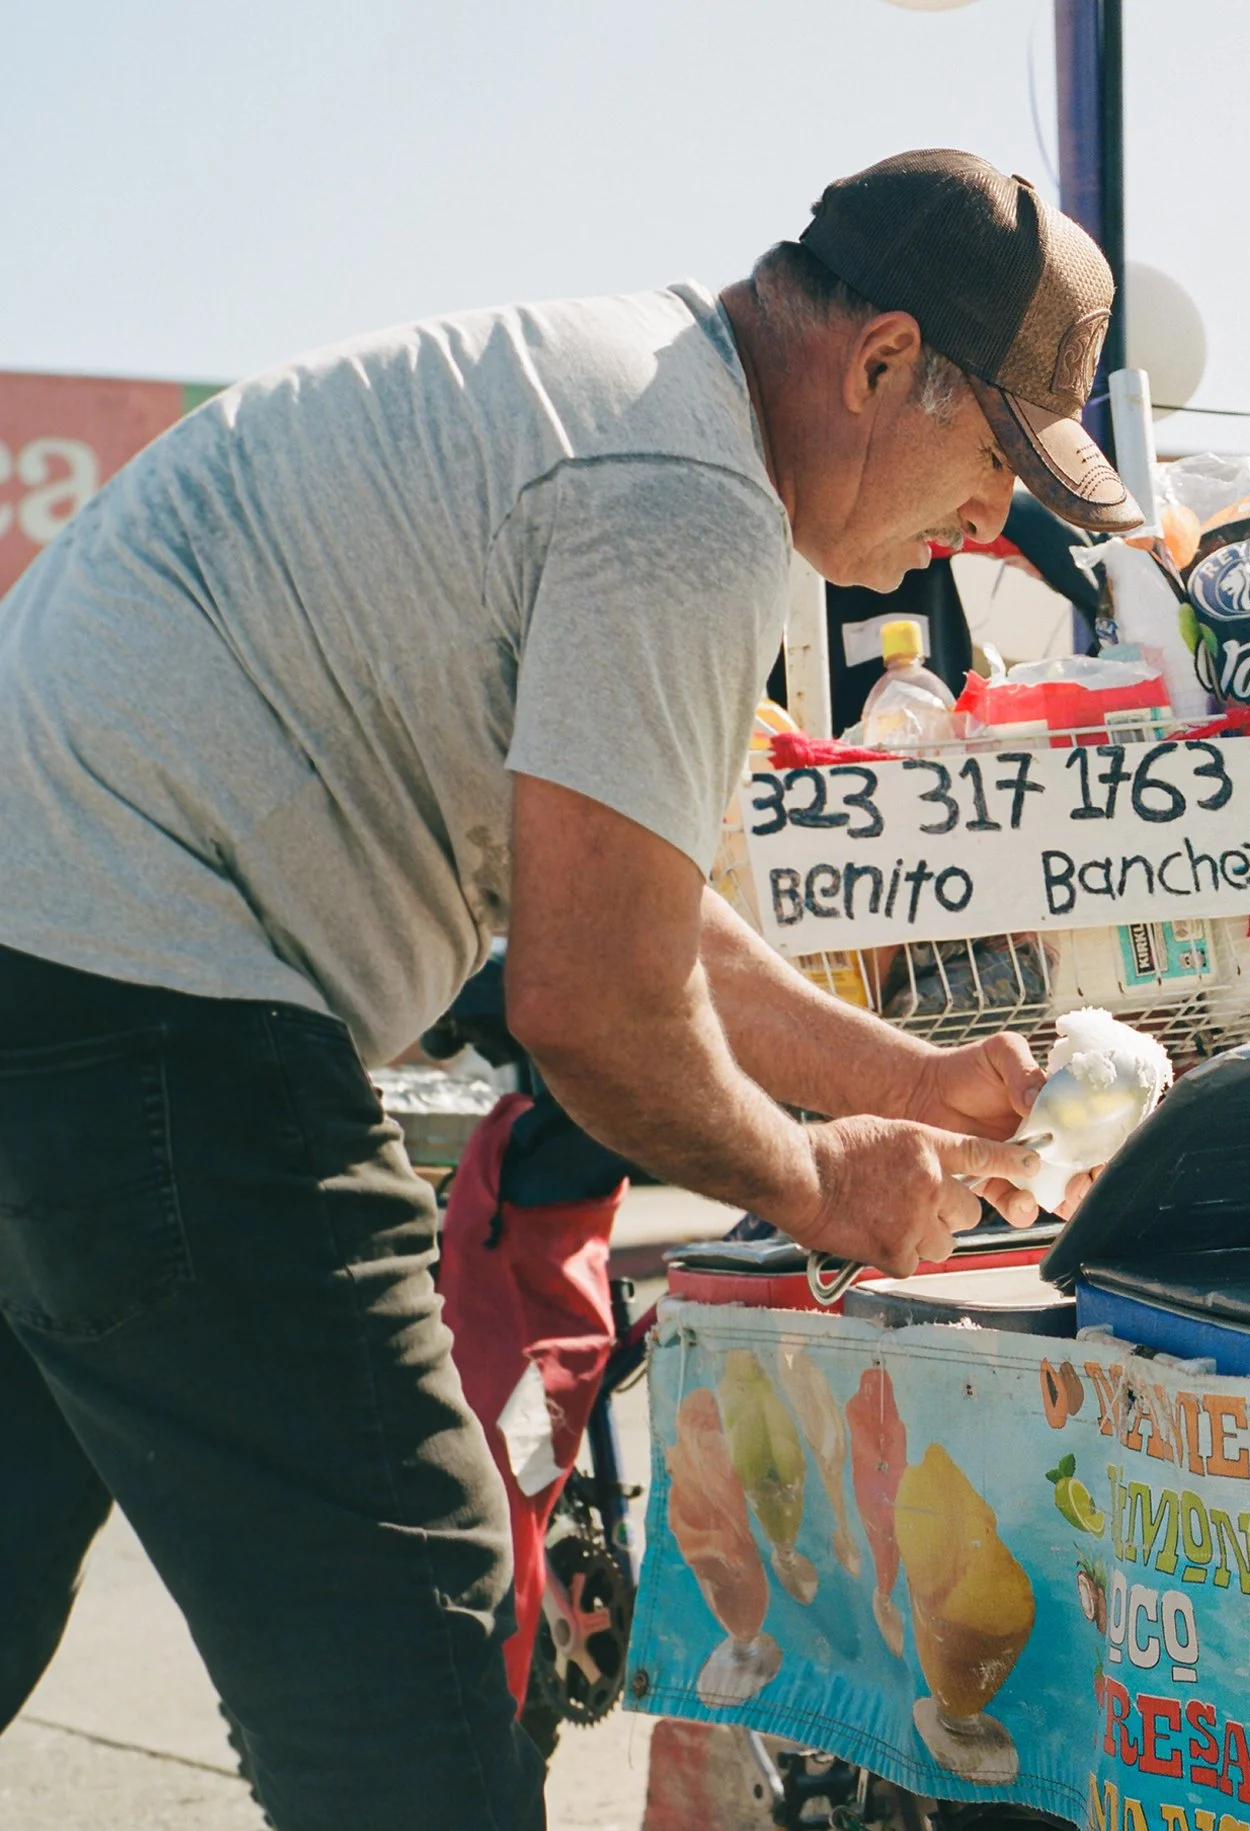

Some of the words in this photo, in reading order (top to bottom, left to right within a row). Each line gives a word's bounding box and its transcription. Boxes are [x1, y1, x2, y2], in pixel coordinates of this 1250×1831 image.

[0, 437, 98, 548] a
[752, 767, 885, 838] 323
[903, 752, 1046, 834] 317
[1065, 741, 1233, 822] 1763
[770, 858, 974, 926] Benito
[1131, 923, 1152, 968] KIRKL
[1108, 1569, 1200, 1684] OCO
